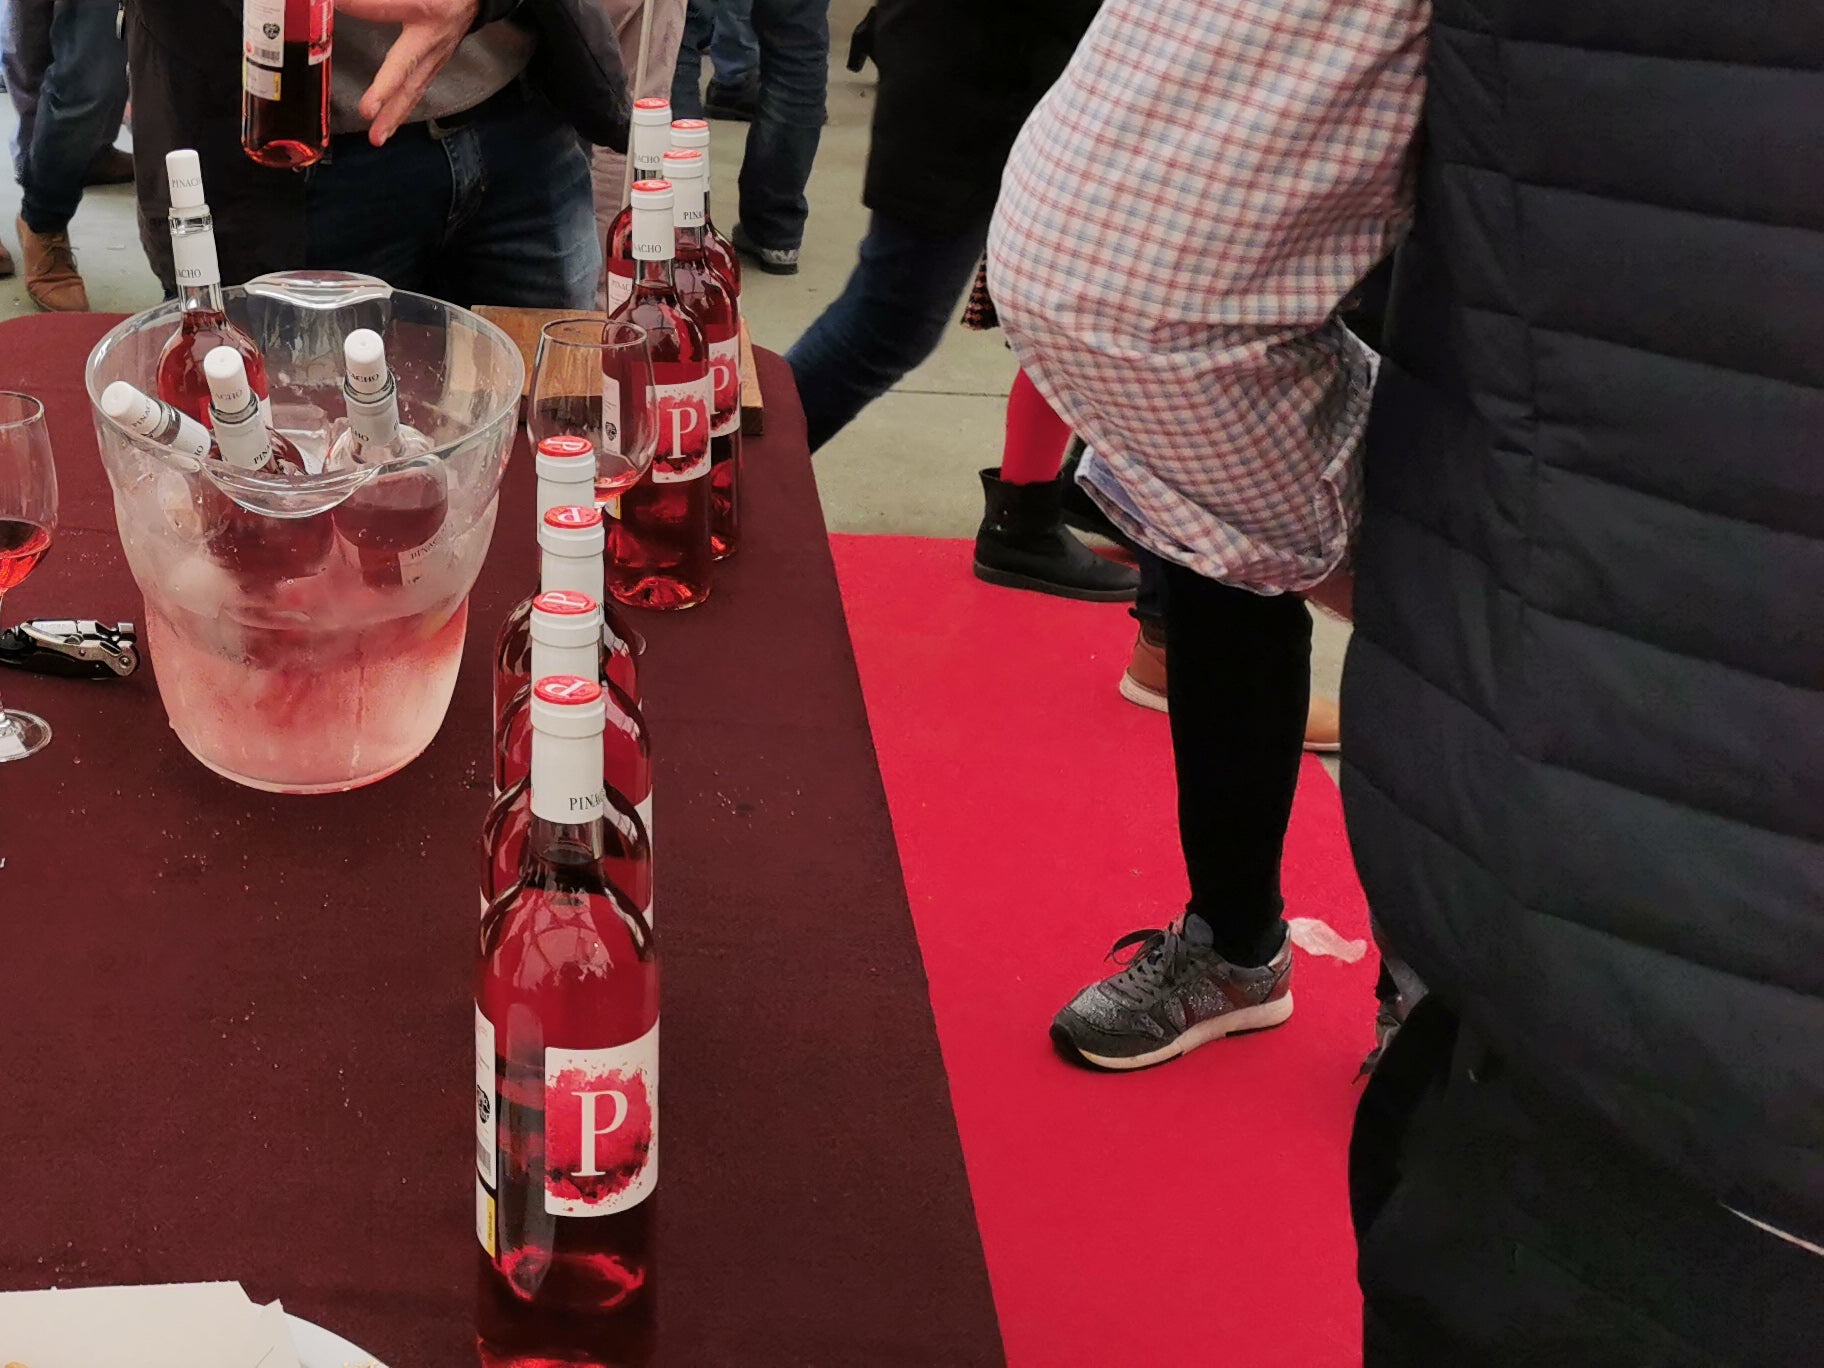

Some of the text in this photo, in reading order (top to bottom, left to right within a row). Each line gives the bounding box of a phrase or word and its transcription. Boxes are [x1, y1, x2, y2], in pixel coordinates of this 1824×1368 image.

[667, 407, 698, 459] P
[542, 591, 588, 609] P
[544, 679, 590, 702] P
[571, 1089, 630, 1177] P
